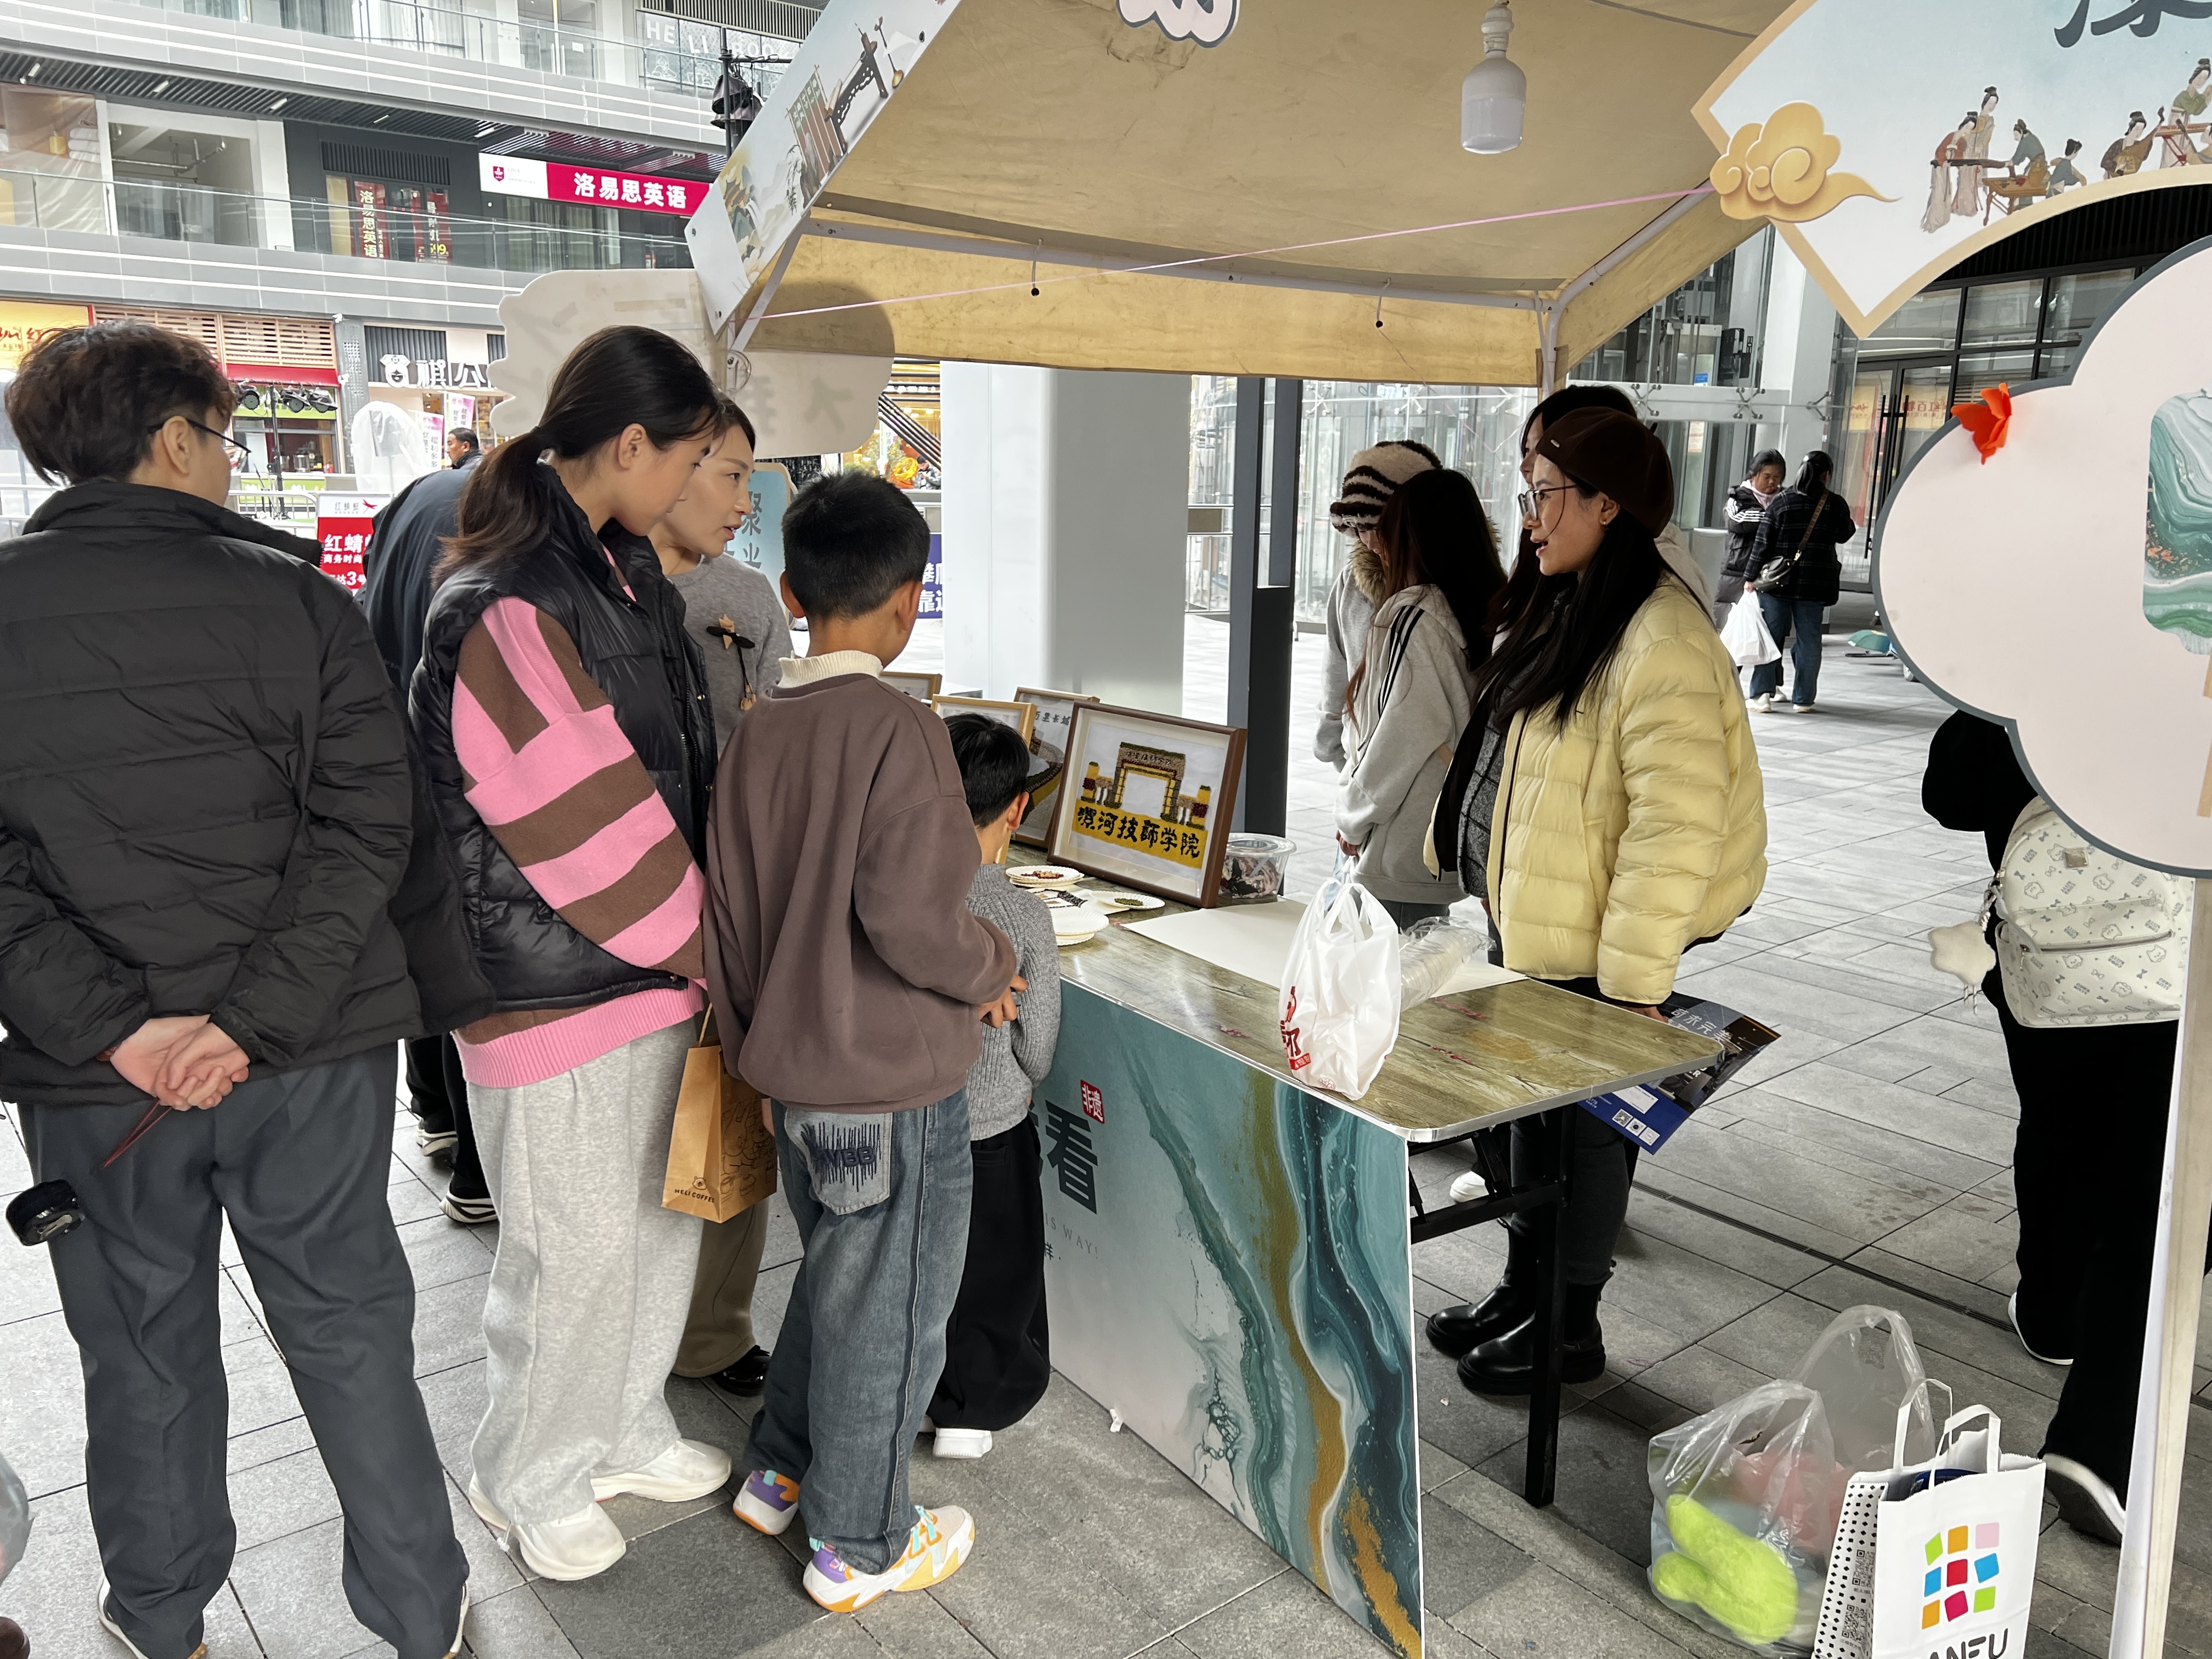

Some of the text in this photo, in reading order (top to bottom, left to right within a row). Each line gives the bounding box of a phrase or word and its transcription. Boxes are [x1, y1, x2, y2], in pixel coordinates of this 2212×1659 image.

[646, 19, 675, 44] HE
[573, 171, 687, 210] 洛易思英语
[360, 190, 377, 258] 洛易思英语
[674, 1188, 691, 1197] HELI
